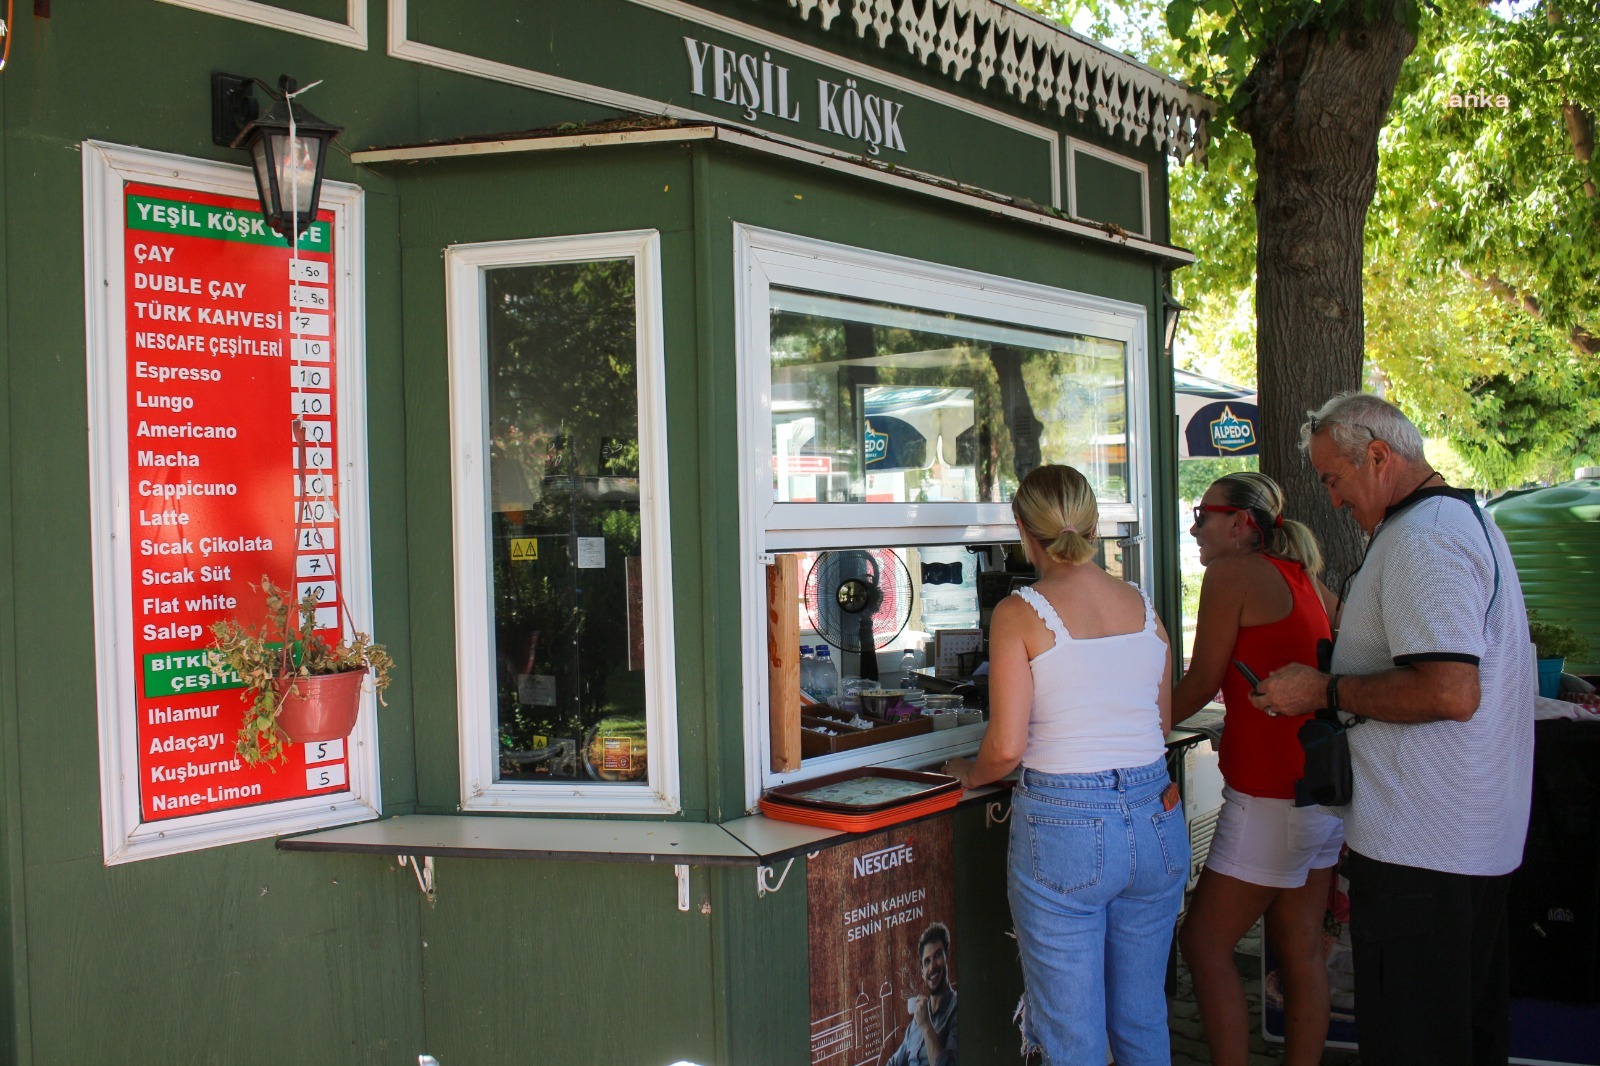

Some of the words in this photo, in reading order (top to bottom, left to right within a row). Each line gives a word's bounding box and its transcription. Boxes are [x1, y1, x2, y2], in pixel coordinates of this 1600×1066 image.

[682, 36, 800, 121] YEŞİL
[817, 78, 907, 156] KÖŞK
[137, 202, 201, 229] YEŞİL
[207, 211, 265, 238] KÖŞK
[134, 243, 175, 263] ÇAY
[134, 272, 202, 295] DUBLE
[208, 280, 247, 301] ÇAY
[134, 301, 191, 323] TÜRK
[199, 307, 283, 330] KAHVESİ
[135, 332, 205, 353] NESCAFE
[209, 335, 283, 358] ÇEŞİTLERİ
[304, 343, 321, 355] 10
[135, 361, 221, 382] Espresso
[300, 370, 321, 386] 10
[136, 391, 195, 413] Lungo
[301, 398, 322, 413] 10
[137, 420, 237, 439] Americano
[1214, 425, 1250, 439] ALPEDO
[138, 450, 200, 467] Macha
[138, 479, 237, 501] Cappicuno
[139, 510, 189, 526] Latte
[303, 504, 324, 520] 10
[141, 538, 193, 556] Sıcak
[199, 536, 273, 557] Çikolata
[304, 532, 323, 547] 10
[142, 567, 195, 585] Sıcak
[200, 564, 231, 583] Süt
[309, 559, 321, 573] 7
[143, 597, 180, 615] Flat
[185, 593, 237, 611] white
[143, 623, 203, 641] Salep
[171, 670, 242, 692] ÇEŞİTL
[148, 703, 220, 726] Ihlamur
[149, 732, 224, 756] Adaçayı
[317, 742, 327, 758] 5
[151, 757, 240, 783] Kuşburnu
[318, 772, 331, 786] 5
[153, 782, 262, 812] Nane-Limon
[844, 903, 879, 926] SENİN
[881, 887, 926, 912] KAHVEN
[847, 921, 882, 942] SENİN
[884, 906, 923, 929] TARZIN
